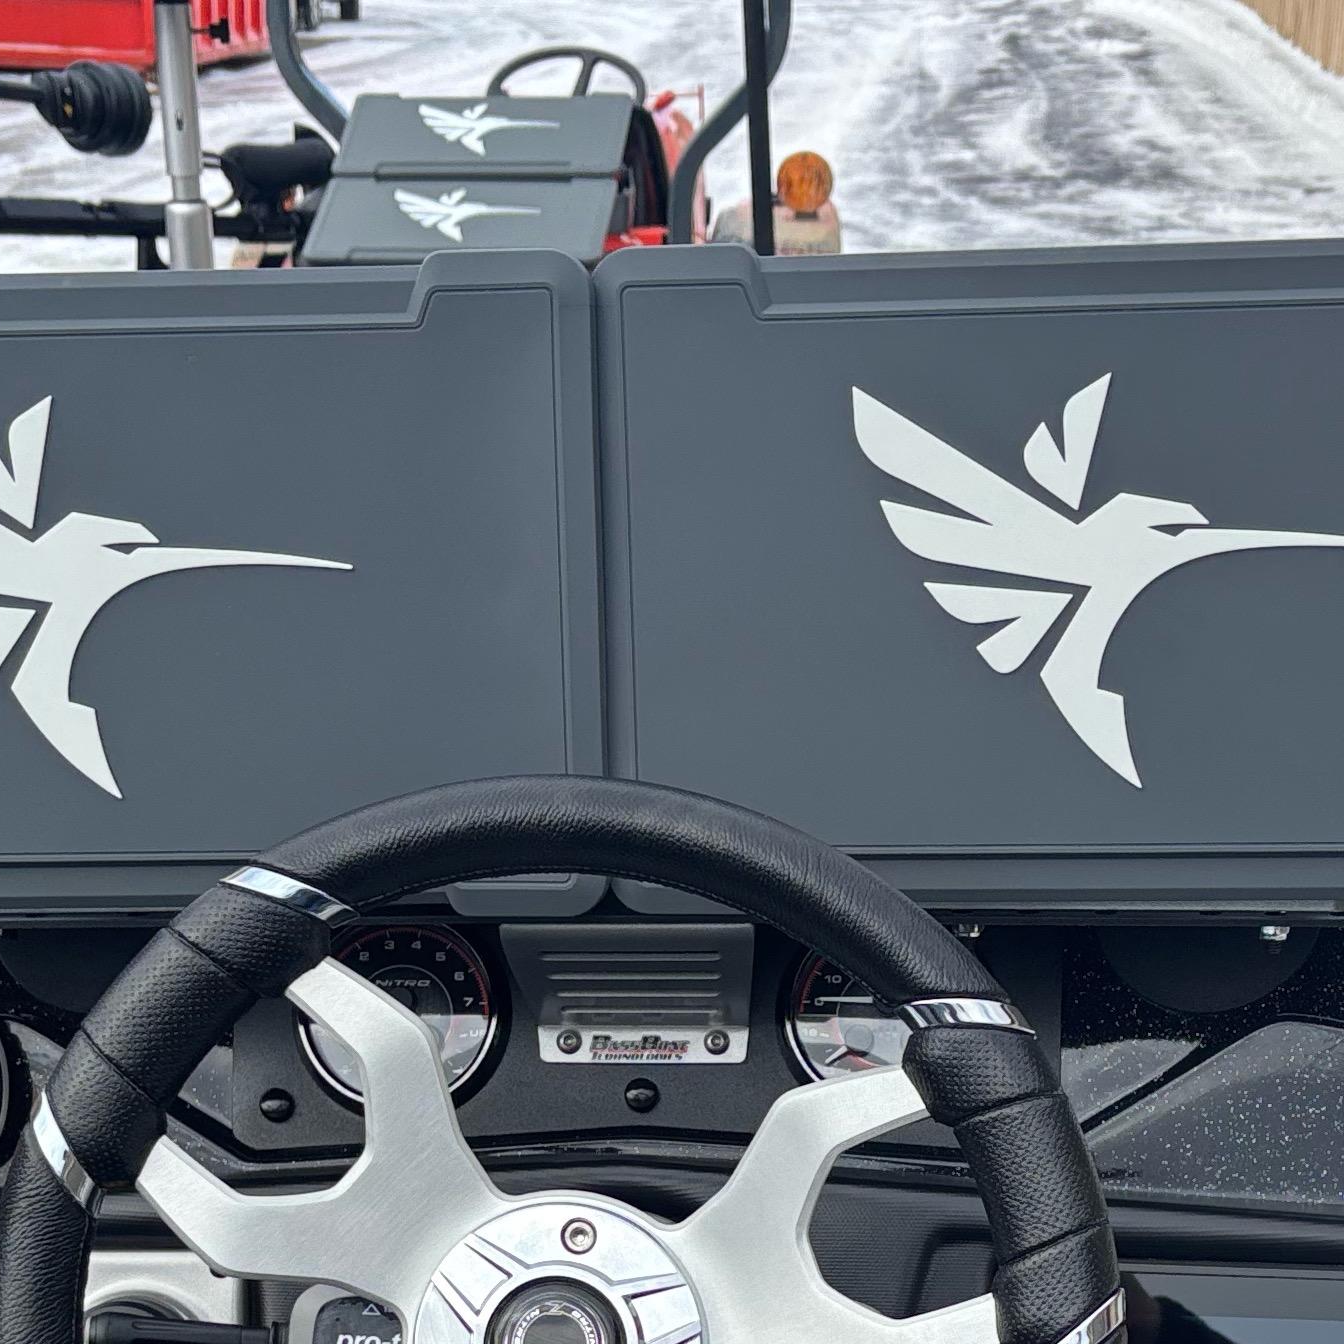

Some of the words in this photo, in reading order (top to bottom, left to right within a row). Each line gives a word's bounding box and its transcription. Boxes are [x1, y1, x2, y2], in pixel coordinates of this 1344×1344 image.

[384, 940, 395, 950] 3
[411, 940, 422, 950] 4
[359, 952, 370, 961] 2
[435, 952, 446, 961] 5
[454, 971, 465, 981] 6
[824, 974, 842, 984] 10
[463, 997, 474, 1006] 7
